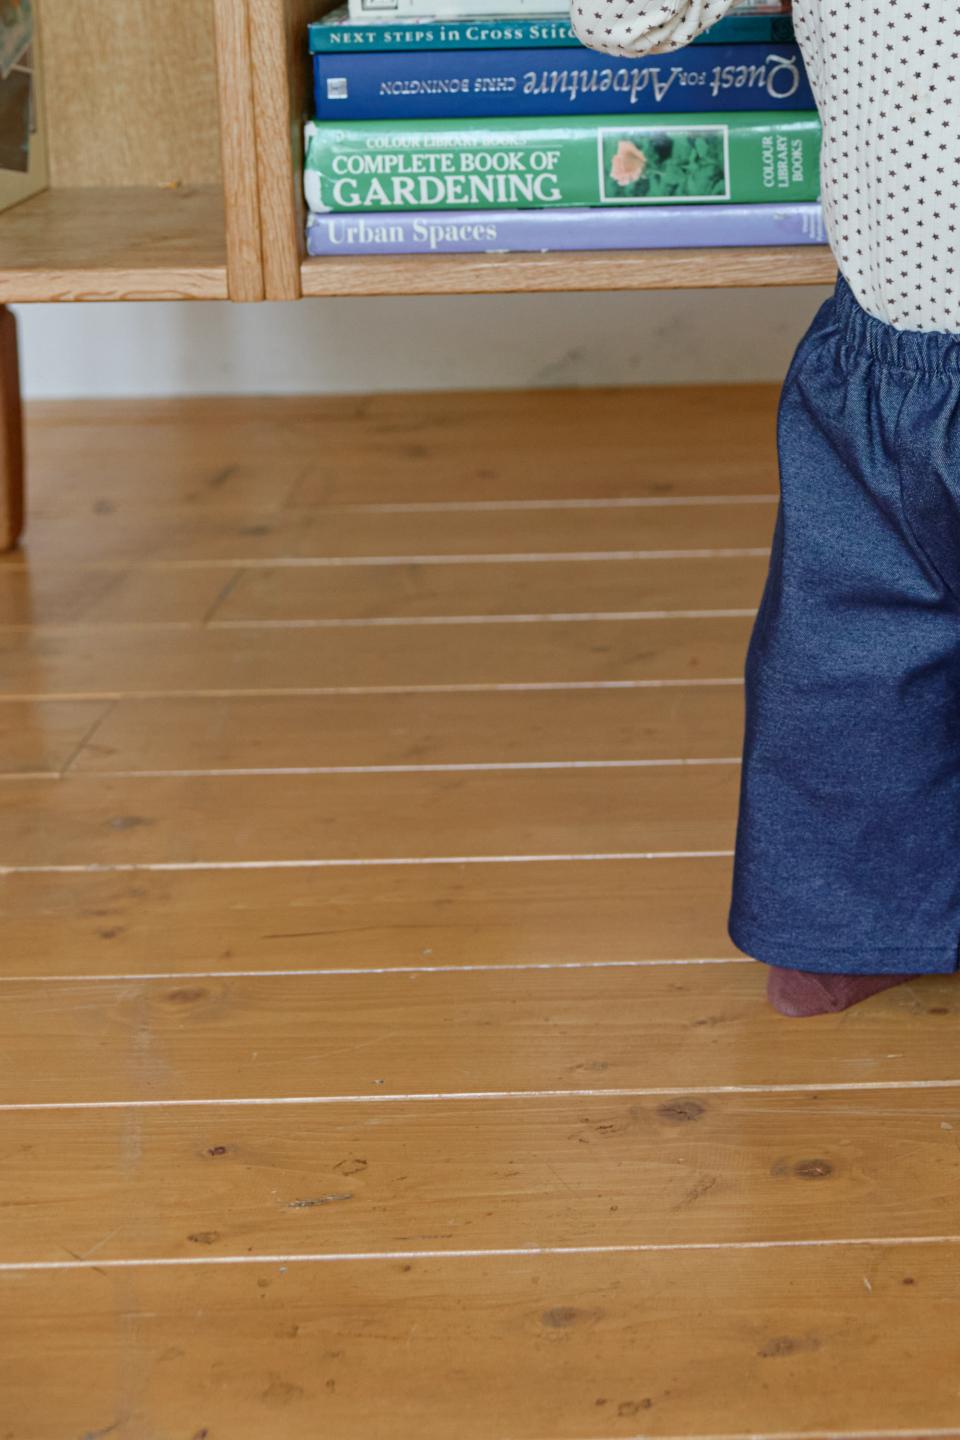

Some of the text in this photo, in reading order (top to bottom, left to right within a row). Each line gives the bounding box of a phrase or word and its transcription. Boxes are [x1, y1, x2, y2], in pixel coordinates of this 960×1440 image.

[330, 24, 576, 44] NEXT STEPS in Cross Stitc
[379, 54, 800, 104] Quest FOR Adventure CHRIS BONINGTON
[366, 136, 420, 149] COLOUR
[423, 135, 479, 148] LIBRARY
[332, 151, 561, 175] COMPLETE BOOK OF
[761, 135, 775, 188] COLOUR
[776, 134, 789, 188] LIBRARY
[791, 139, 804, 182] BOOKS
[333, 173, 562, 207] GARDENING
[327, 217, 497, 250] Urban Spaces
